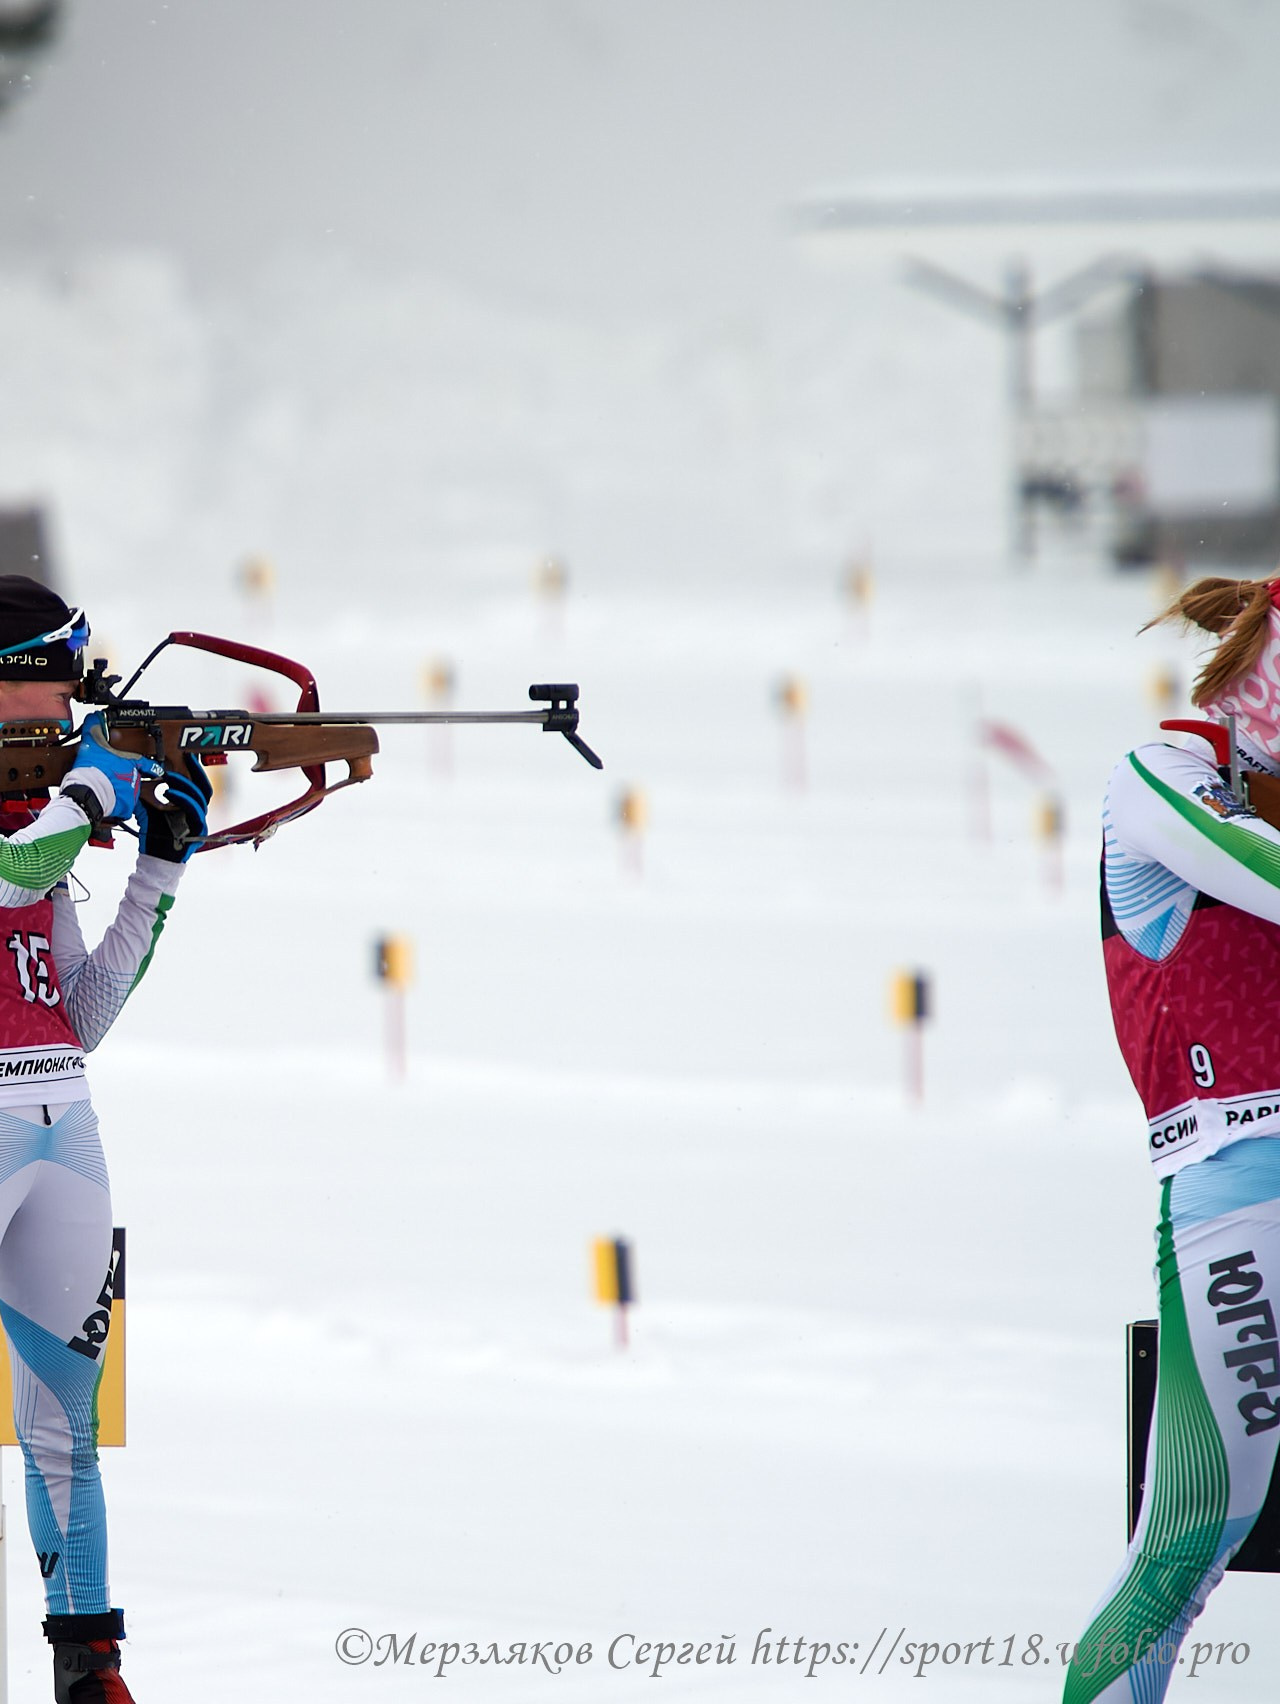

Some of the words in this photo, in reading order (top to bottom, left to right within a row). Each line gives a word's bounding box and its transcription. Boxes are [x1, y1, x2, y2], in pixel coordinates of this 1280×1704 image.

[180, 724, 252, 747] PARI
[1236, 746, 1270, 778] RAFT
[6, 930, 61, 1008] 15
[1188, 1043, 1216, 1088] 9
